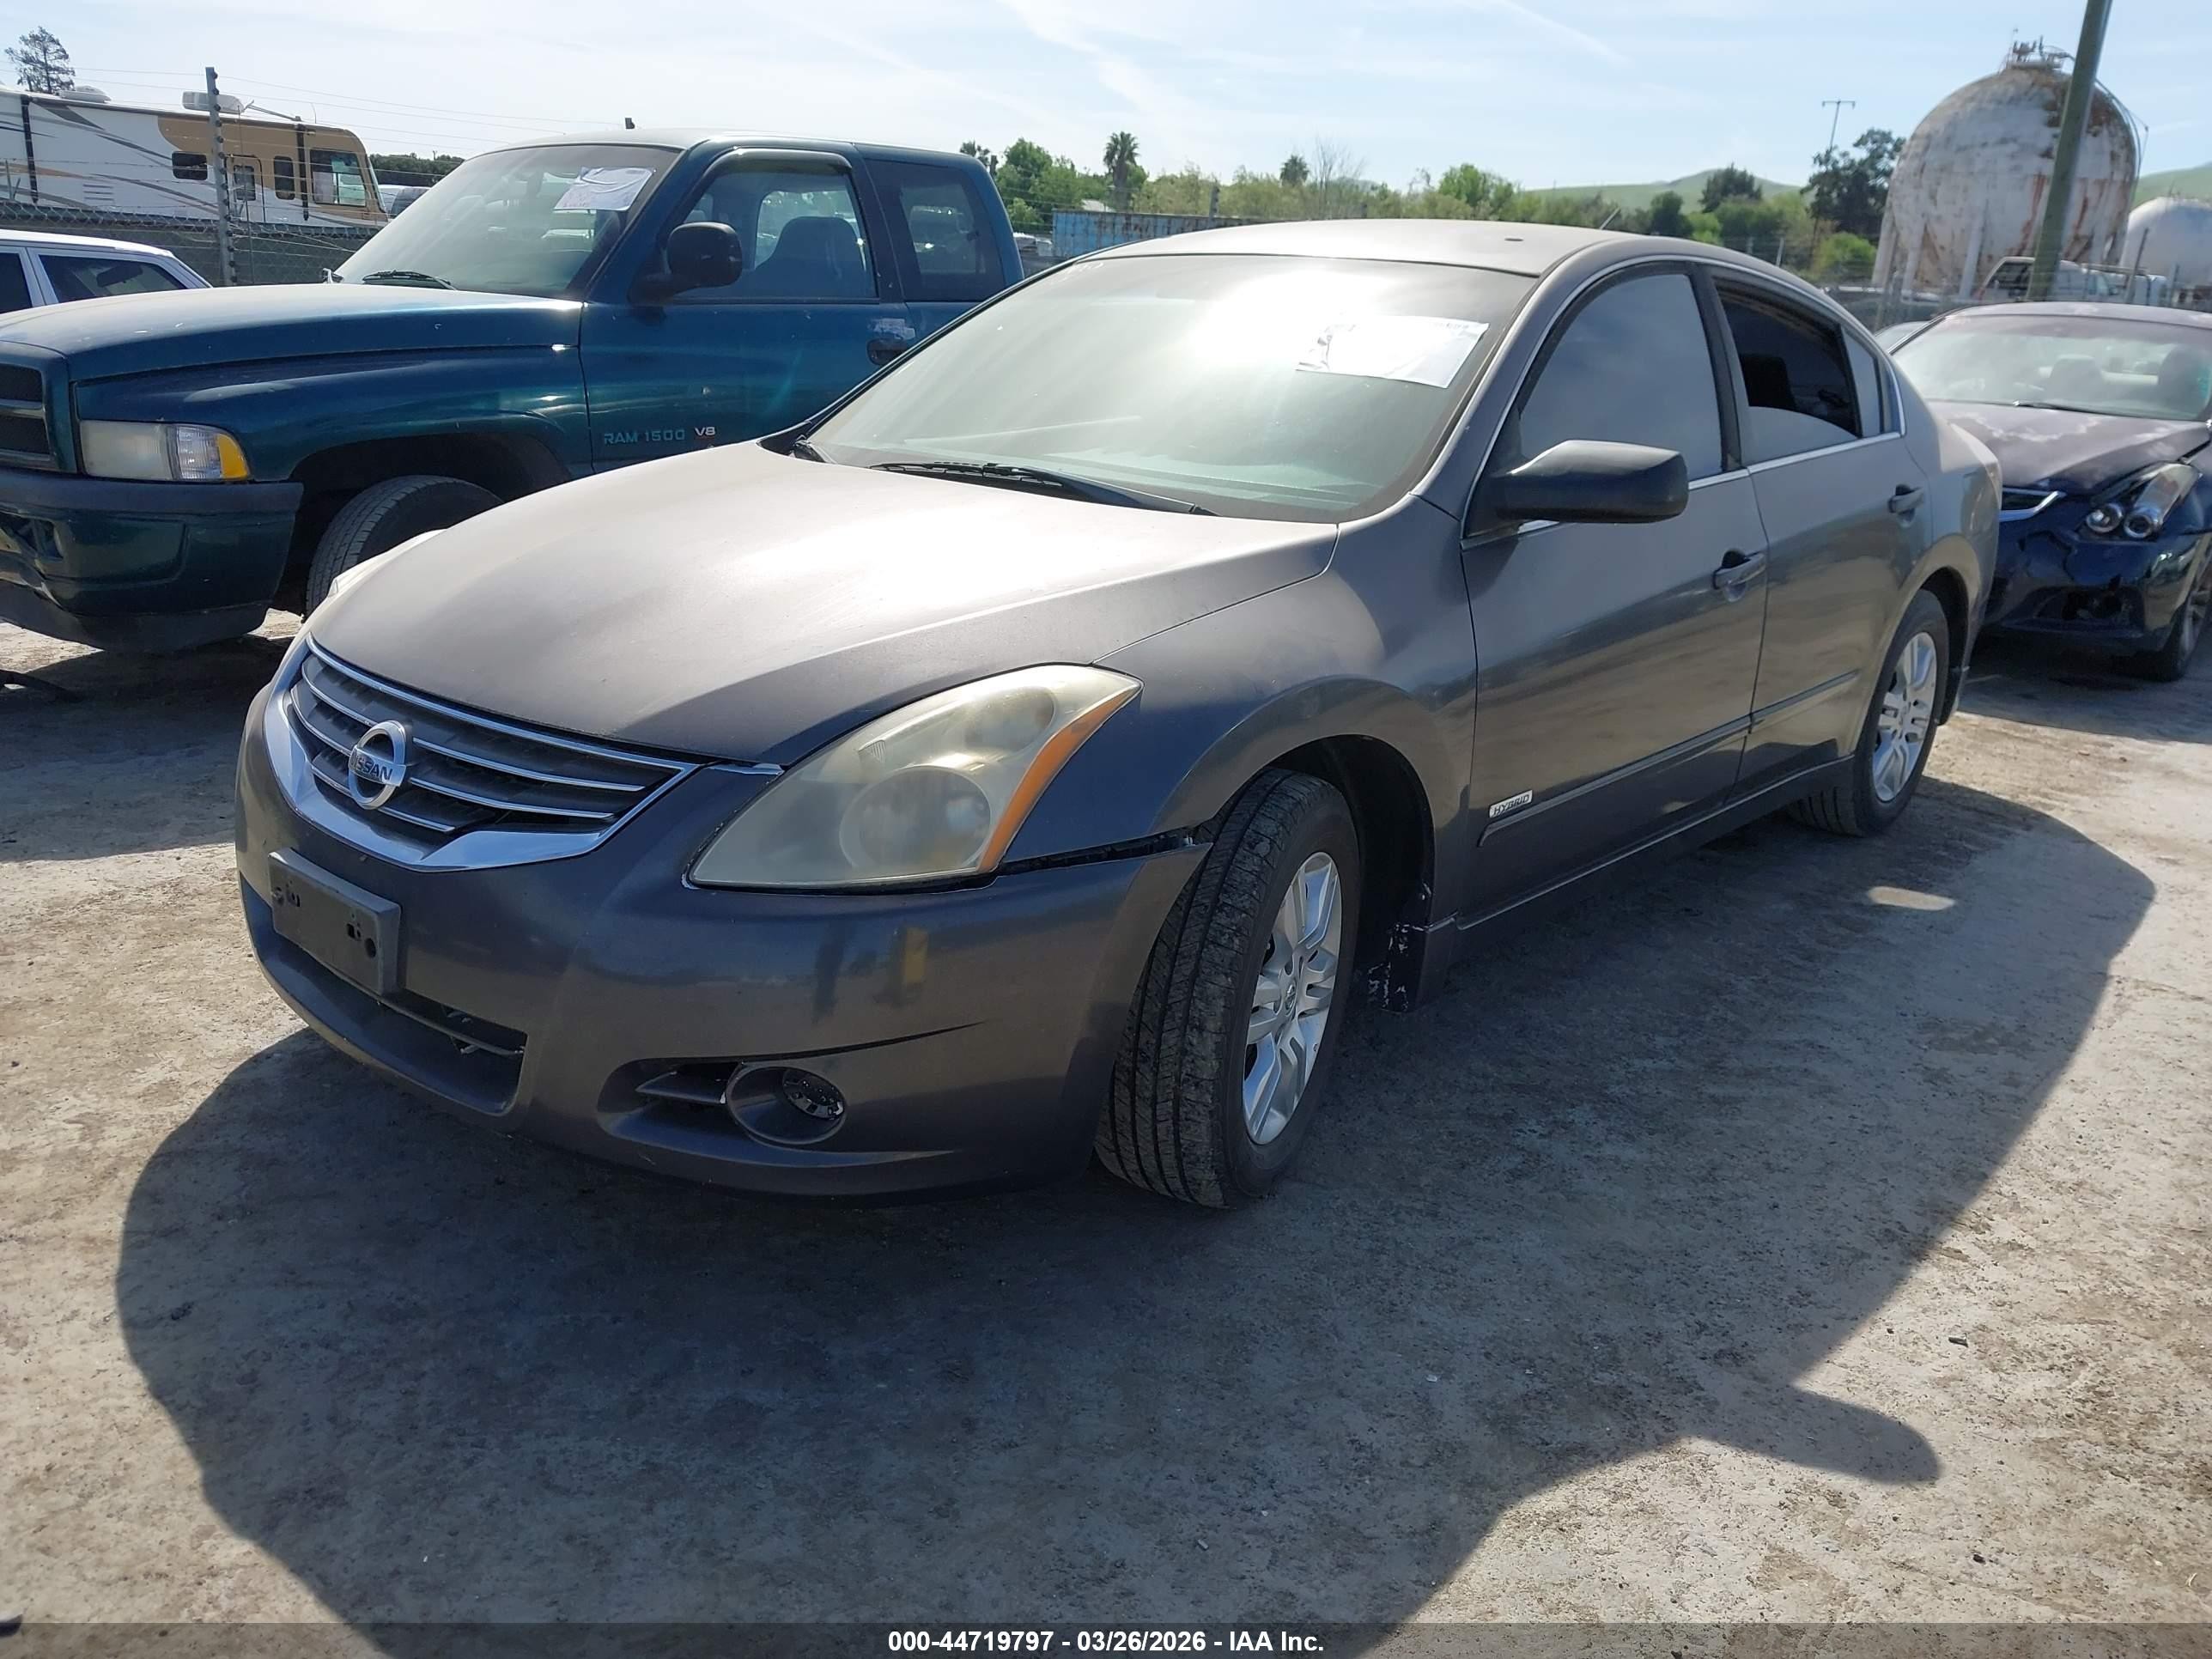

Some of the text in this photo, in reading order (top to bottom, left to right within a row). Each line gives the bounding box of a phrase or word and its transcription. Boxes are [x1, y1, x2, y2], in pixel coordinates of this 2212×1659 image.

[604, 426, 716, 445] RAM 1500 V8
[1492, 794, 1530, 817] HYBRID
